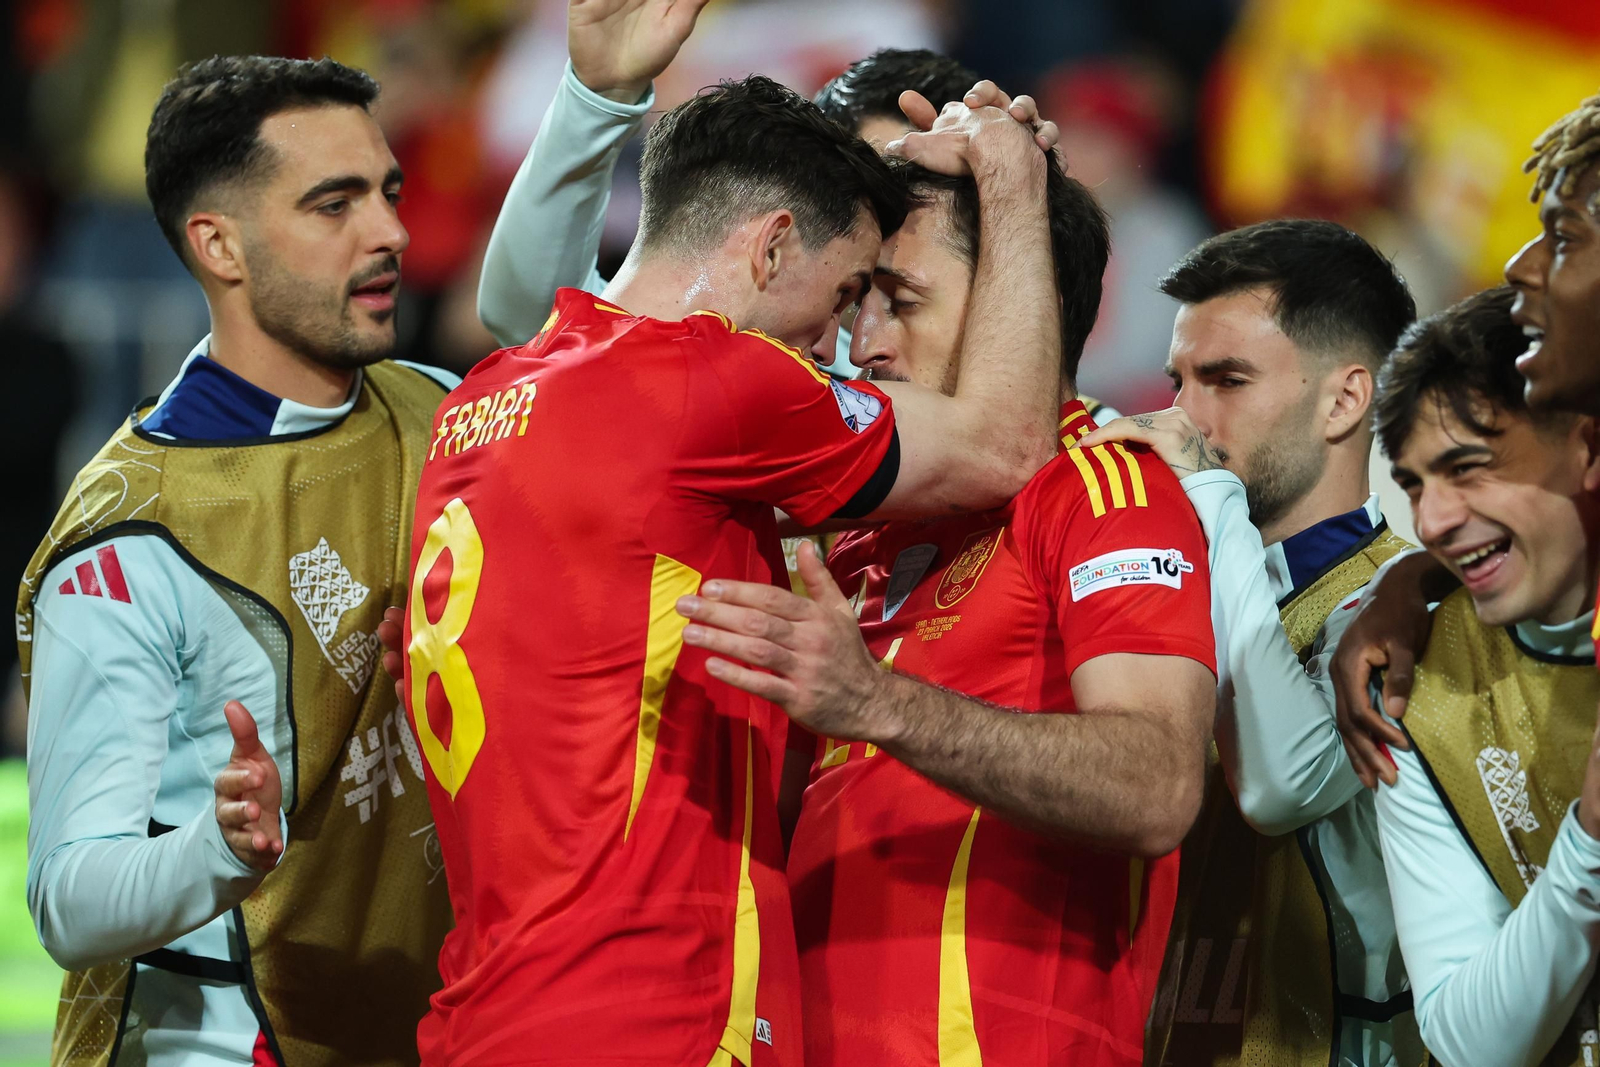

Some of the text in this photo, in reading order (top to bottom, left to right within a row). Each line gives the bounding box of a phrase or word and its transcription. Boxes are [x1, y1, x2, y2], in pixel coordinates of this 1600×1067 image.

[429, 383, 537, 461] FABIAN
[1071, 565, 1089, 577] UEFA
[1073, 562, 1149, 589] FOUNDATION
[1120, 576, 1128, 584] for
[1151, 557, 1178, 577] 10
[924, 625, 940, 634] MARCH
[333, 630, 367, 660] UEFA
[336, 629, 381, 681] NATIO
[408, 497, 486, 802] 8
